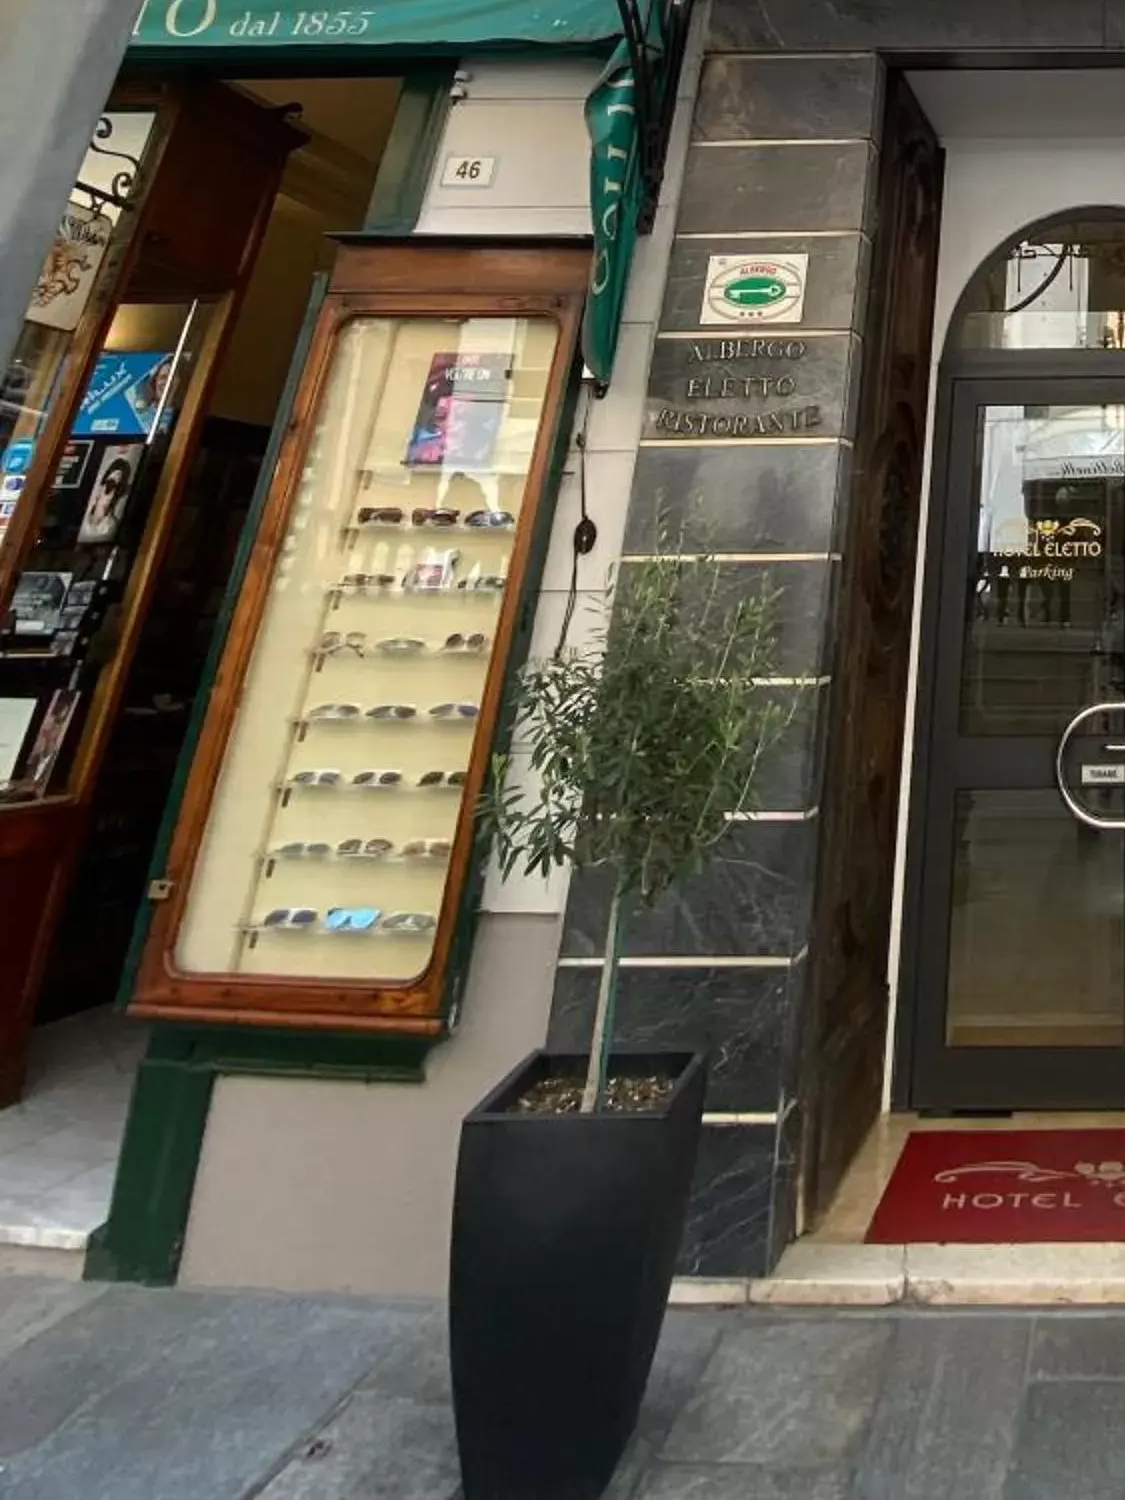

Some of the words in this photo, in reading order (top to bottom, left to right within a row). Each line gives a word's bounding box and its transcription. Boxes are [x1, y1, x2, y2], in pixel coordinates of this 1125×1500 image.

[229, 11, 279, 38] dal
[291, 10, 376, 37] 1855
[455, 160, 482, 181] 46
[688, 340, 805, 362] ALBERGO
[687, 376, 797, 398] ELETTO
[655, 405, 822, 434] RISTORANTE
[1044, 541, 1102, 557] ELETTO
[1021, 563, 1075, 580] Parking
[941, 1191, 1082, 1210] HOTEL
